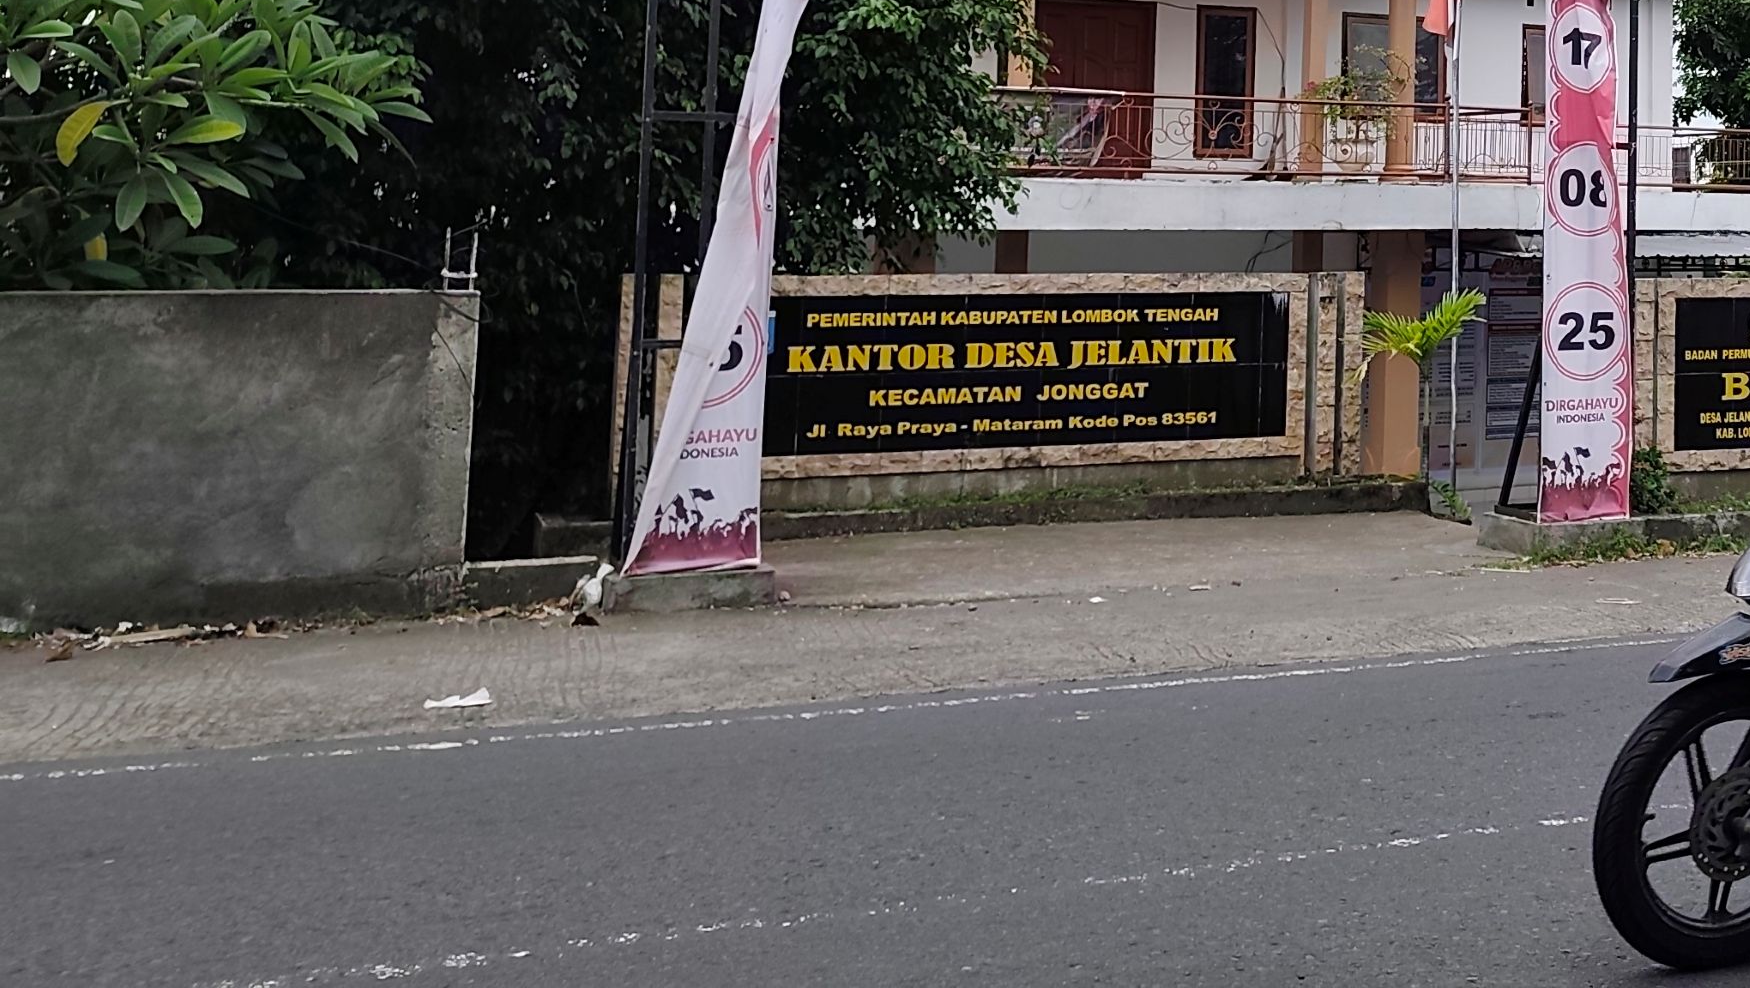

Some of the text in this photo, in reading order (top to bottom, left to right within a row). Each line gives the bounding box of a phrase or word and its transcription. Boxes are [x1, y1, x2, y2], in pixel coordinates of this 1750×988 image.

[1562, 28, 1602, 69] 17
[1559, 169, 1607, 207] 08
[806, 308, 1219, 327] PEMERINTAH KABUPATEN LOMBOK TENGAH
[1557, 312, 1615, 351] 25
[717, 325, 743, 371] 5
[786, 338, 1236, 372] KANTOR DESA JELANTIK
[1685, 349, 1718, 360] BADAN
[869, 382, 1149, 407] KECAMATAN JONGGAT
[1545, 397, 1619, 412] DIRGAHAYU
[837, 422, 892, 439] Raya
[897, 421, 957, 437] Praya
[972, 418, 1063, 433] Mataram
[1068, 414, 1118, 429] Kode
[1123, 413, 1158, 427] Pos
[1161, 411, 1217, 425] 83561
[1556, 413, 1606, 424] INDONESIA
[1700, 412, 1722, 424] DESA
[686, 428, 757, 445] GAHAYU
[1715, 427, 1737, 439] KAB.
[680, 447, 739, 459] DONESIA
